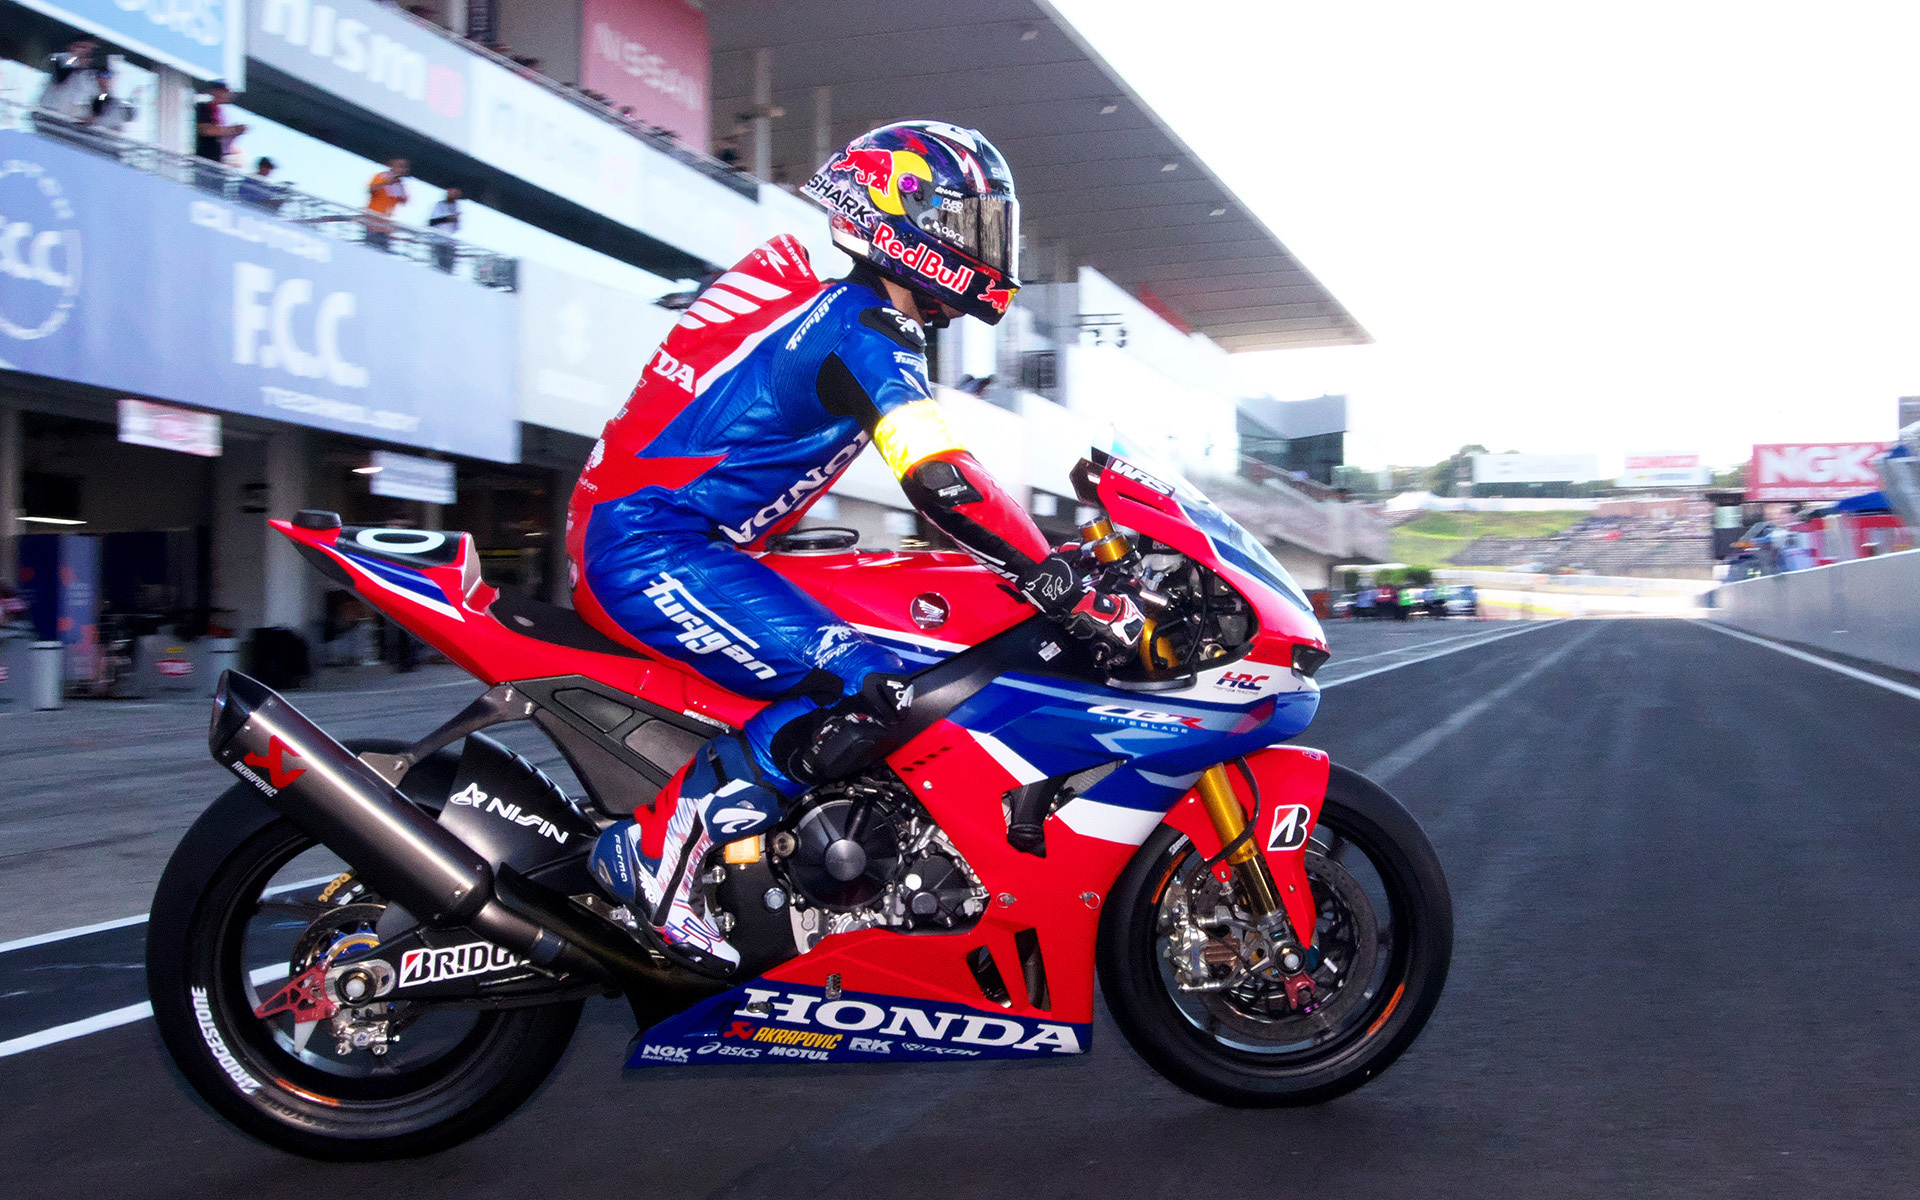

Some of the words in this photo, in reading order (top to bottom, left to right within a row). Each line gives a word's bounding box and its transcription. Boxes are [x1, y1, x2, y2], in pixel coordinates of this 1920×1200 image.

[805, 173, 872, 225] SHARK
[1111, 459, 1175, 495] WRS
[1759, 446, 1890, 485] NGK
[1215, 671, 1271, 691] HRC
[1100, 715, 1189, 734] FIREBLADE
[733, 987, 1083, 1055] HONDA
[191, 985, 263, 1096] BRIDGESTONE
[643, 1044, 691, 1060] NGK
[768, 1046, 829, 1061] MOTUL
[849, 1037, 894, 1050] RK
